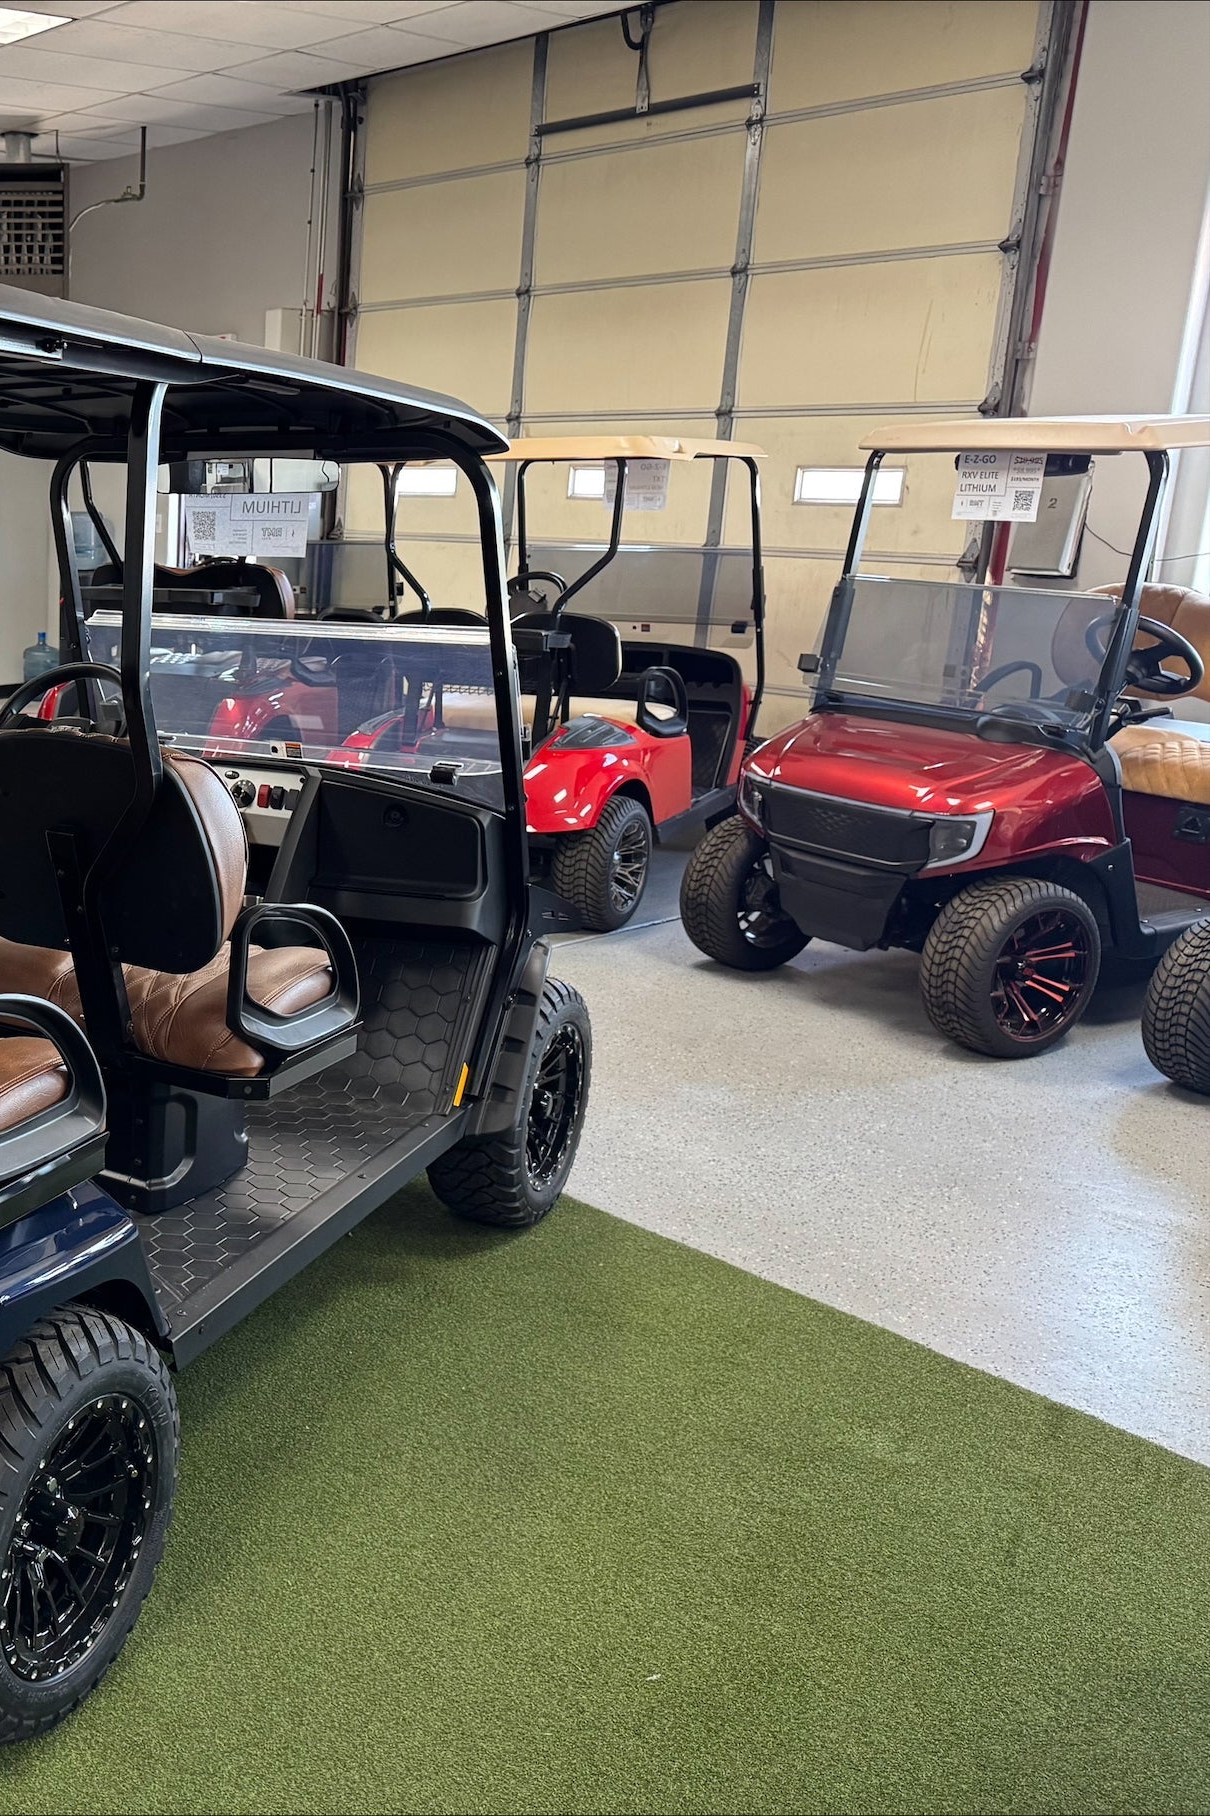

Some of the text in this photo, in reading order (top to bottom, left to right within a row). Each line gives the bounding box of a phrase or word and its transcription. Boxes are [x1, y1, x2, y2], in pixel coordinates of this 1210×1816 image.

[964, 455, 997, 464] E-Z-GO
[962, 471, 999, 480] RXV ELITE
[959, 483, 997, 493] LITHIUM
[1048, 498, 1058, 509] 2
